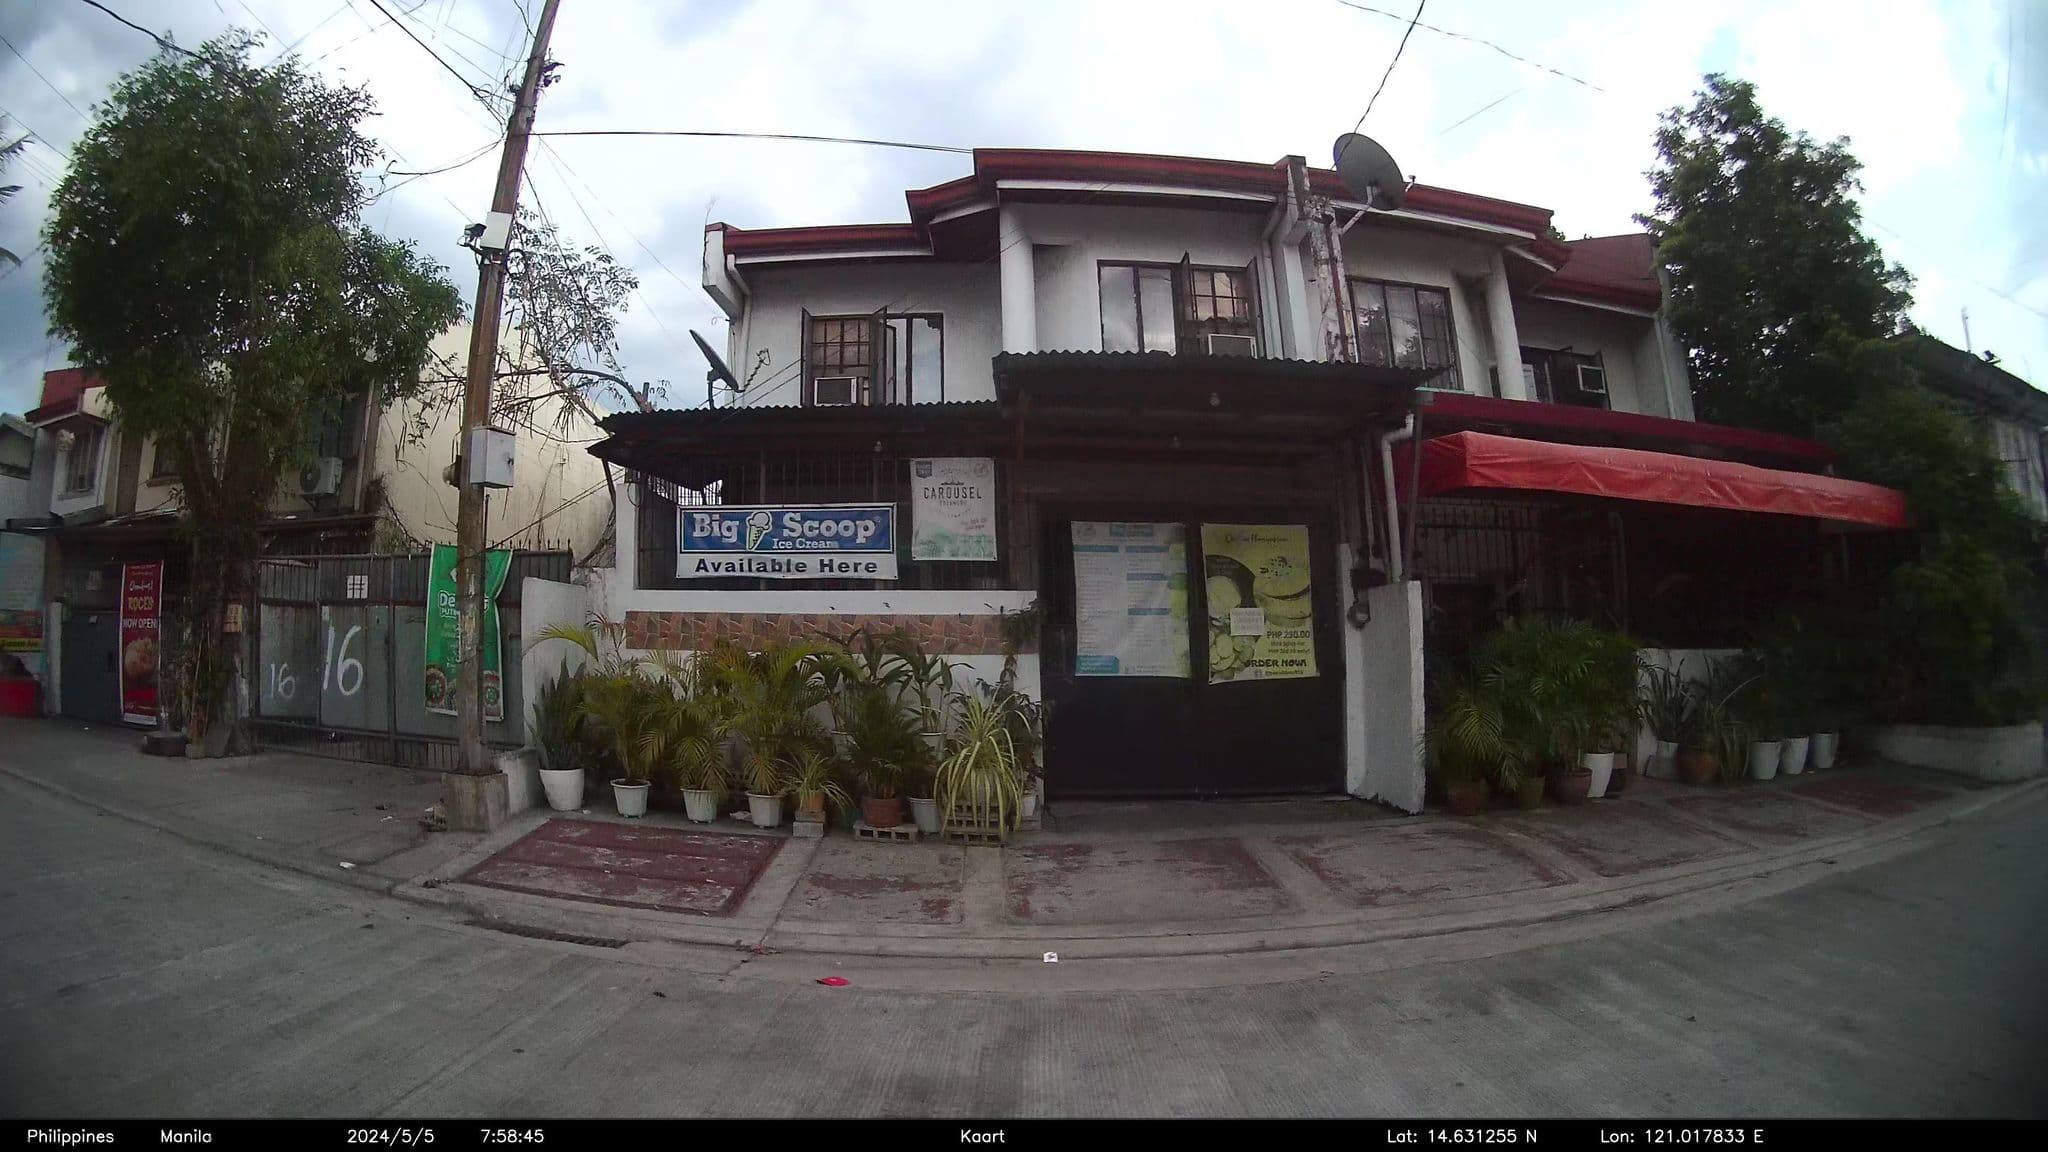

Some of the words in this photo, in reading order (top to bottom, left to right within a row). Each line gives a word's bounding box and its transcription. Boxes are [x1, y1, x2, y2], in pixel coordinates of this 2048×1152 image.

[923, 486, 982, 499] CAROUSEL
[692, 513, 740, 543] Big
[782, 512, 877, 544] Scoop
[772, 538, 792, 549] Ice
[795, 538, 839, 550] Cream
[695, 558, 808, 573] Available
[819, 558, 878, 573] Here
[322, 624, 364, 697] 16
[1245, 659, 1280, 668] ORDER
[270, 661, 297, 700] 16
